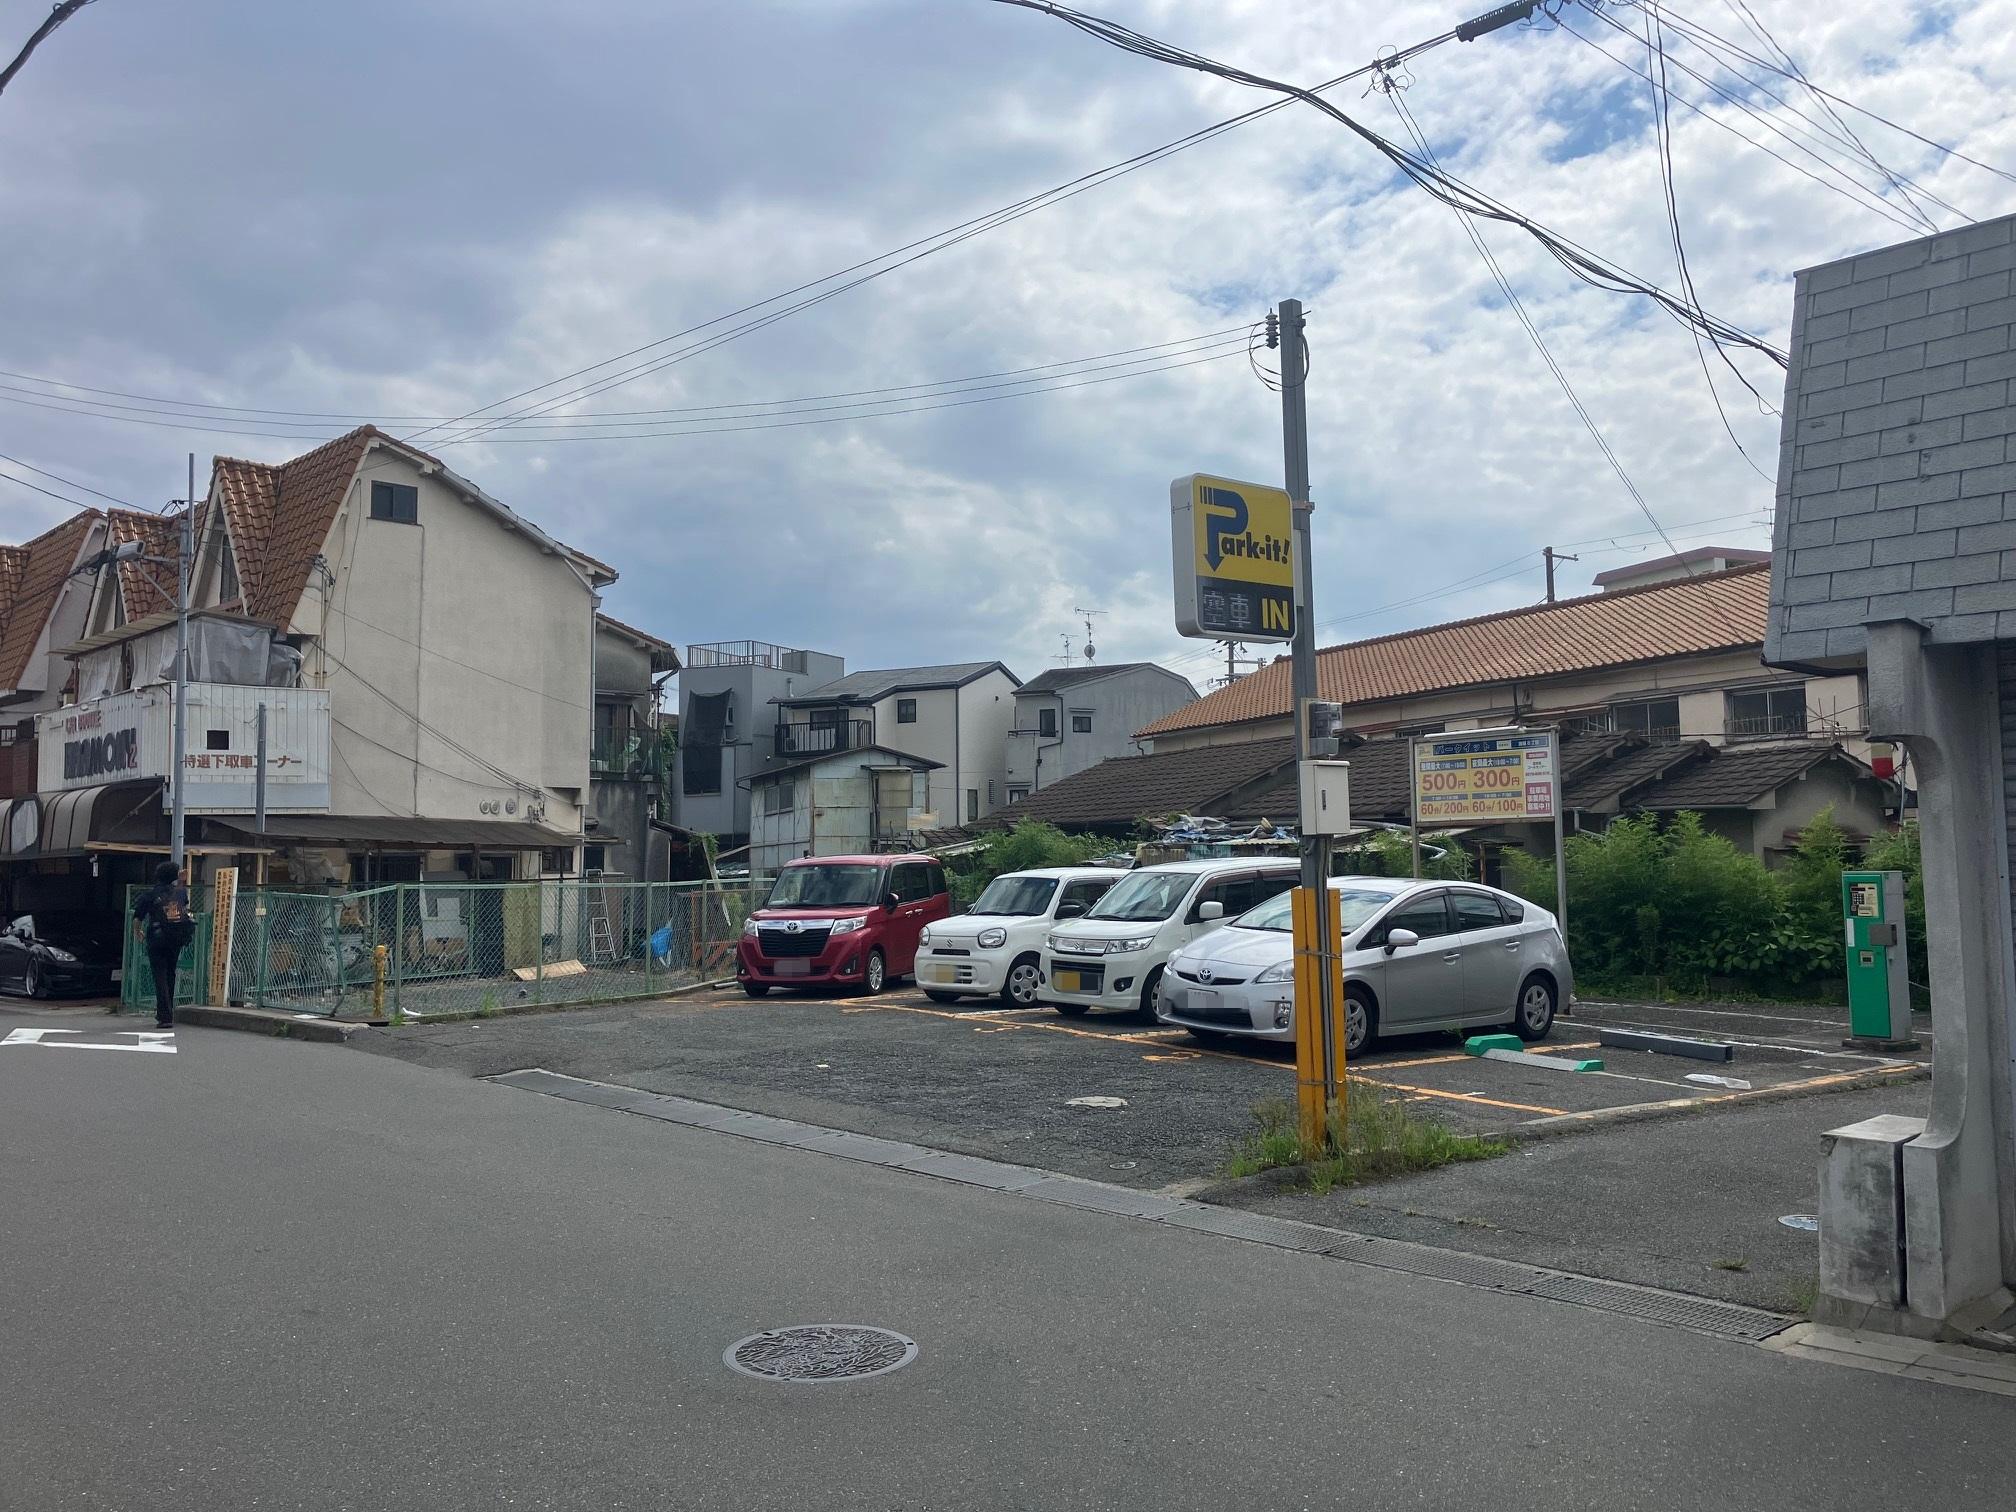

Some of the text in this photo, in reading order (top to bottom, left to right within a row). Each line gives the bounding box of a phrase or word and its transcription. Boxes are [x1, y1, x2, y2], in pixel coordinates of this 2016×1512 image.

[1261, 598, 1290, 631] IN
[1422, 772, 1466, 791] 500円
[1473, 768, 1520, 789] 300円
